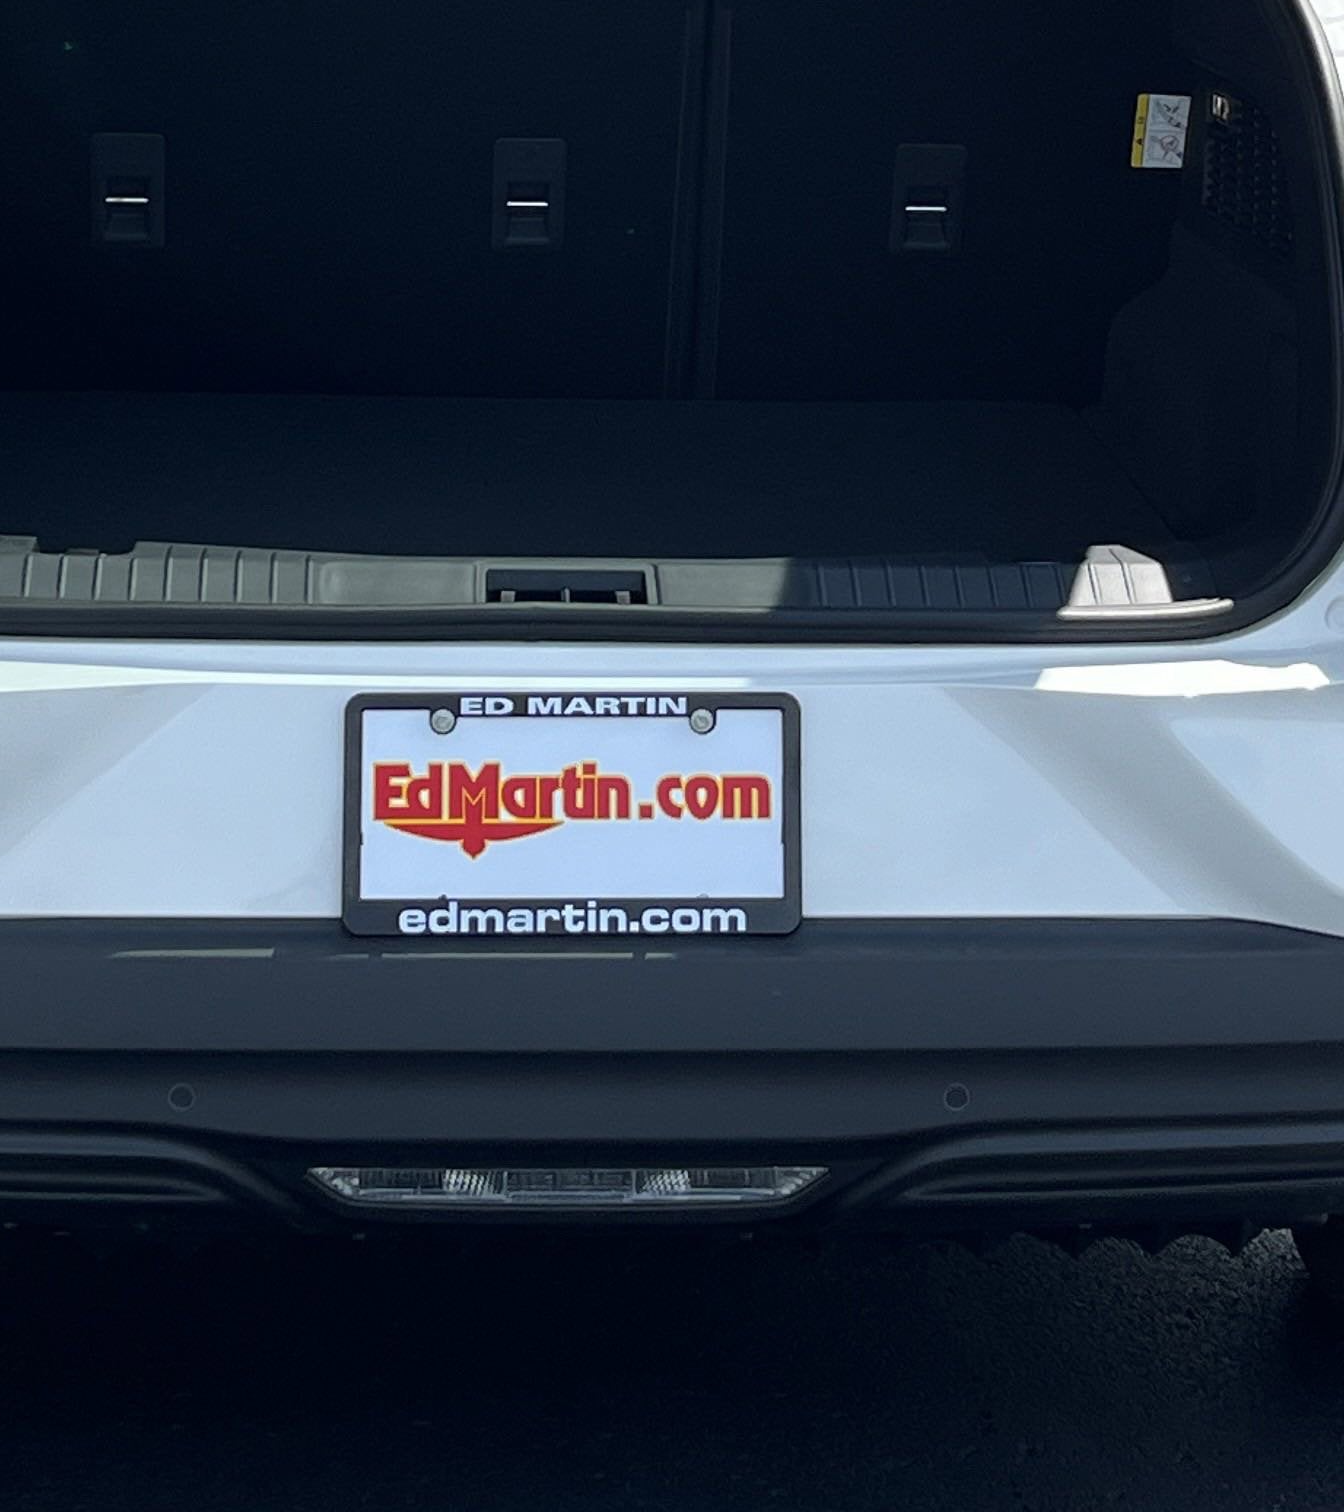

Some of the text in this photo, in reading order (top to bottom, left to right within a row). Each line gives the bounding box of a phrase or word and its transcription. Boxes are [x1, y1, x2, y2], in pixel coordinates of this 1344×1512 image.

[460, 697, 688, 715] ED MARTIN
[372, 761, 772, 826] EdMartin.com
[398, 901, 747, 934] edmartin.com
